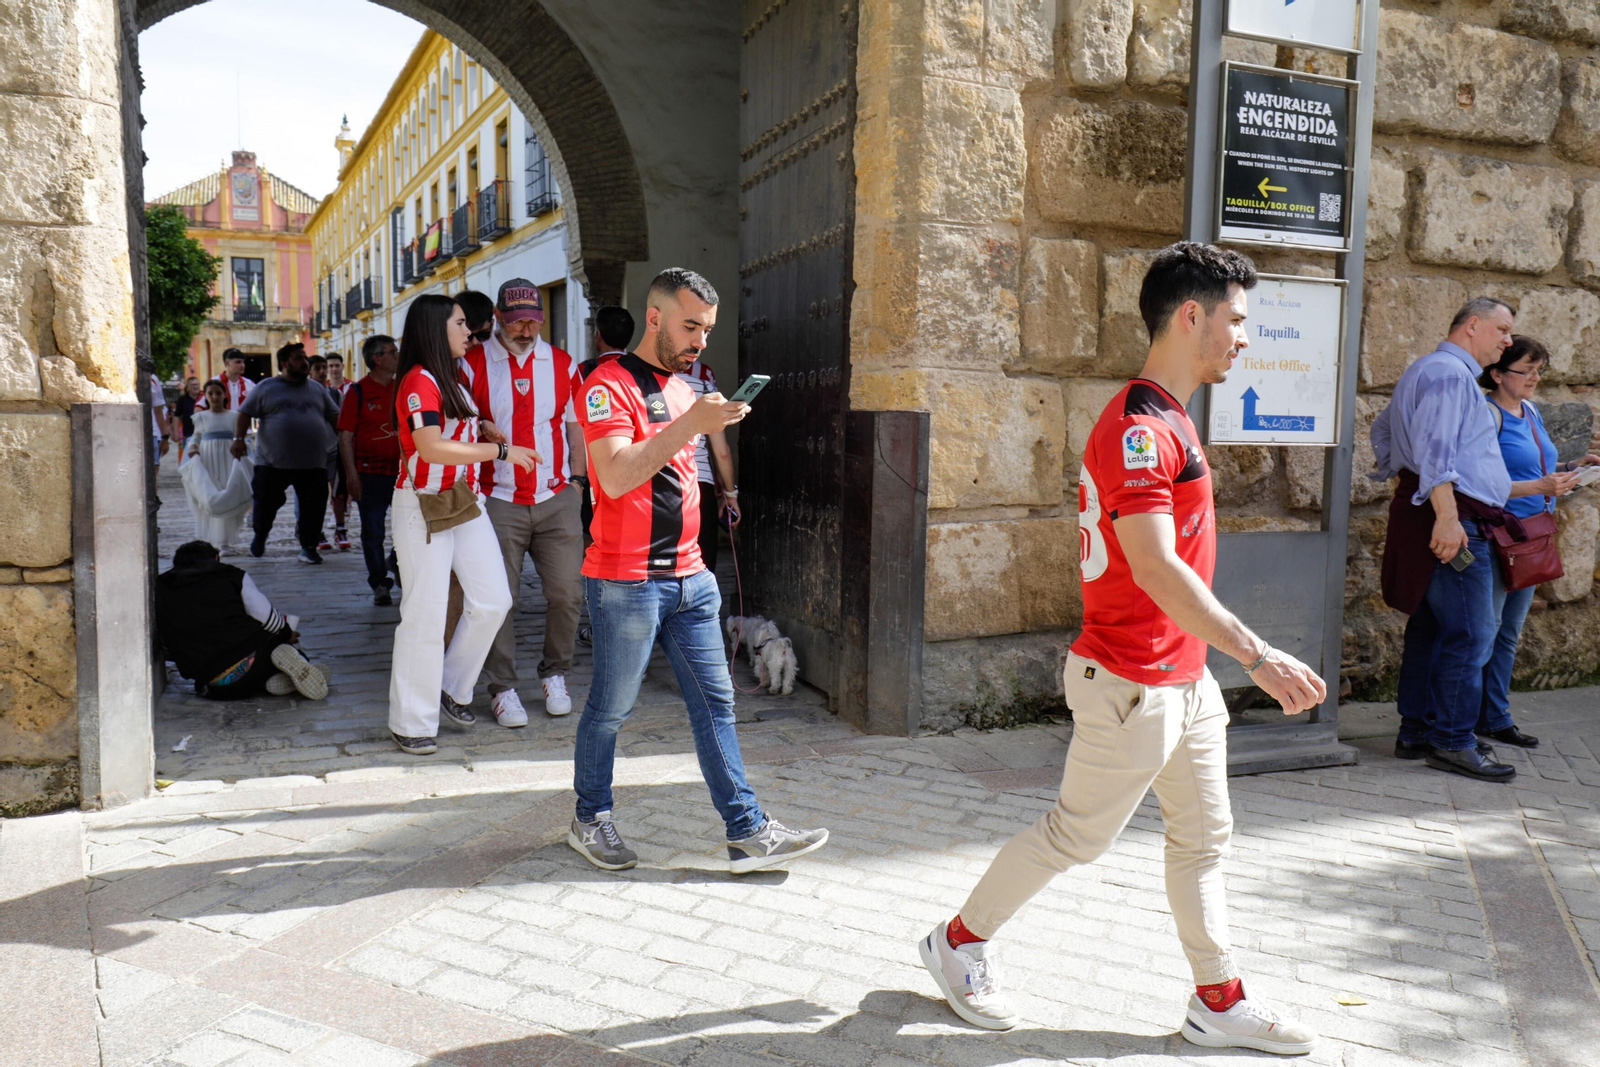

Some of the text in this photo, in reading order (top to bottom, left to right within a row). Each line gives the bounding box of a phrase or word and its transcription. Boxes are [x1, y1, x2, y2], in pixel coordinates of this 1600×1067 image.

[1243, 90, 1333, 117] NATURALEZA
[1236, 106, 1339, 137] ENCENDIDA
[1240, 126, 1337, 147] REAL ALCÁZAR DE SEVILLA
[1228, 150, 1251, 158] CUANDO
[1257, 153, 1271, 161] PONE
[1293, 157, 1315, 166] ENCIENDE
[1322, 161, 1343, 170] HISTORIA
[1289, 165, 1310, 174] HISTORY
[1310, 168, 1327, 176] LIGHTS
[1225, 205, 1254, 215] MIÉRCOLES
[1259, 209, 1286, 218] DOMINGO
[1226, 197, 1316, 214] TAQUILLA/BOX OFFICE
[507, 288, 536, 301] ROCK
[1256, 324, 1301, 341] Taquilla
[1242, 356, 1311, 373] Ticket Office
[588, 408, 609, 418] LaLiga
[1127, 454, 1155, 464] LaLiga
